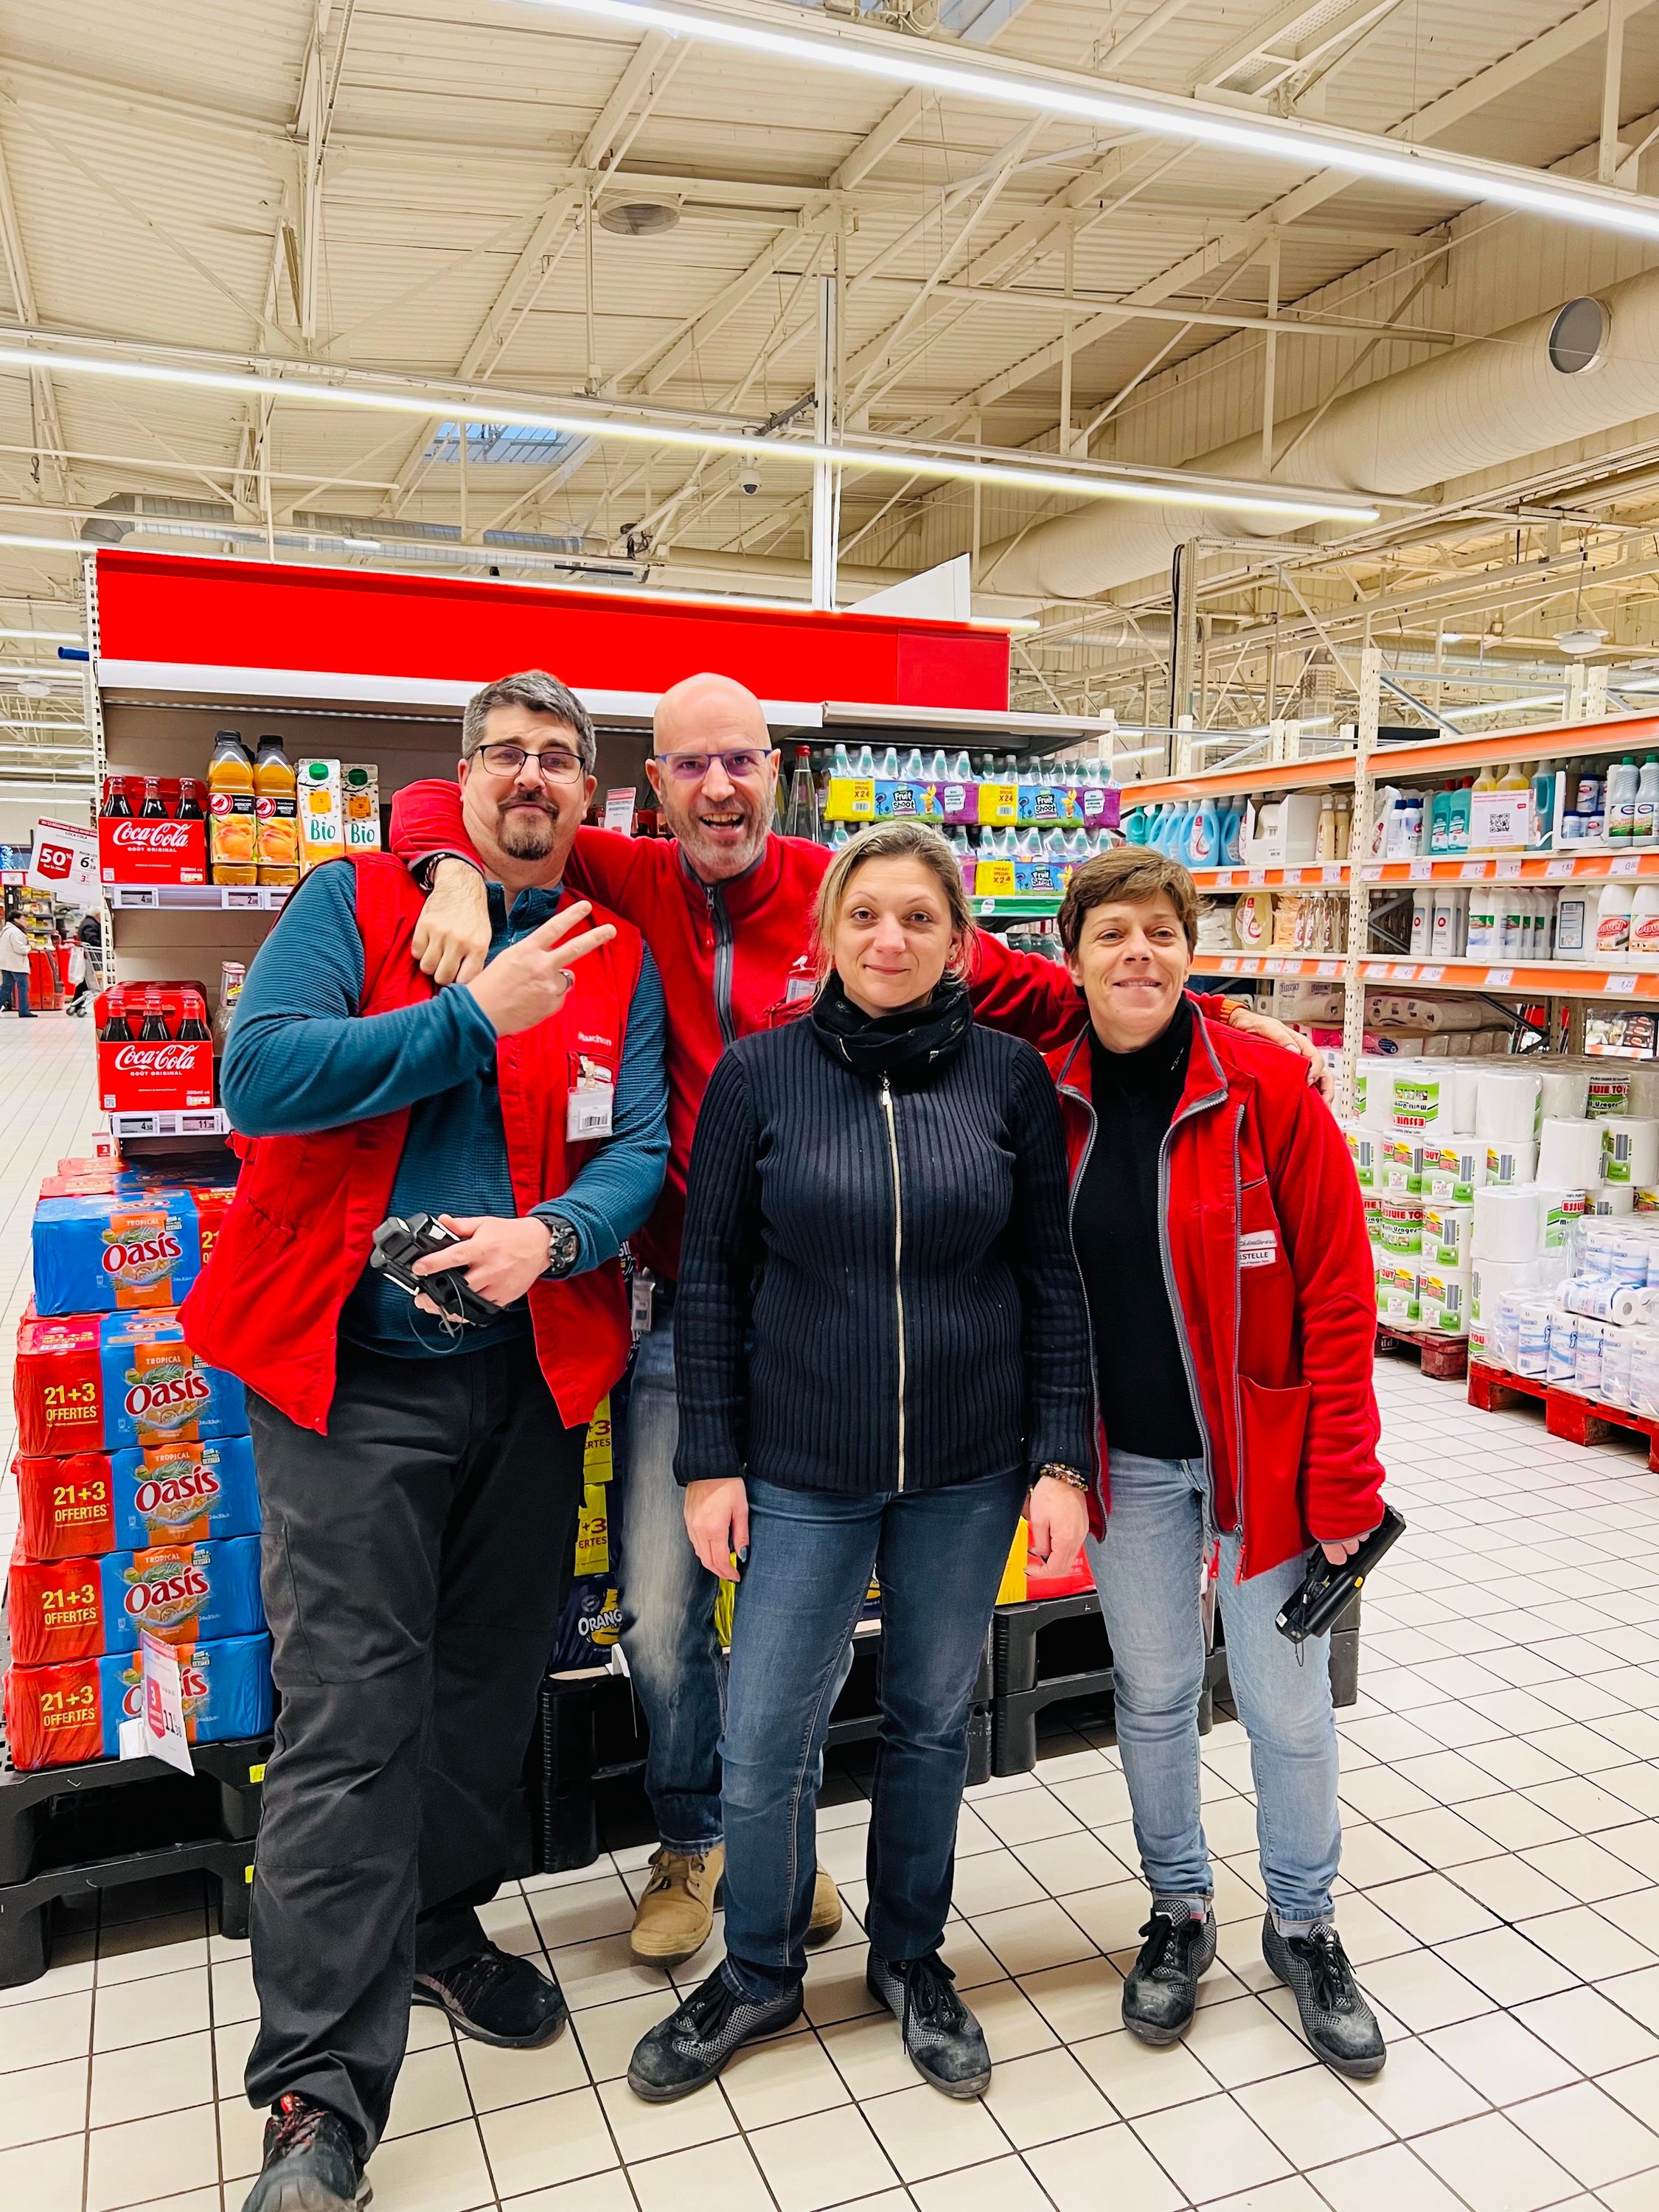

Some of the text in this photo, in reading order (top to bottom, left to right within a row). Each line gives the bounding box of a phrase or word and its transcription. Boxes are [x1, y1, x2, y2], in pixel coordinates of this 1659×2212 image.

[894, 790, 913, 801] Fruit
[1037, 795, 1054, 805] Fruit
[893, 801, 915, 810] Shoot
[1036, 804, 1057, 813] Shoot
[113, 821, 192, 847] Coca-Cola
[311, 819, 335, 841] Bio
[351, 823, 375, 844] Bio
[1032, 871, 1050, 879] Fruit
[115, 1044, 200, 1071] Coca-Cola
[1589, 1085, 1610, 1093] SUIE
[1383, 1144, 1394, 1154] OUT
[1563, 1201, 1585, 1211] ESSU
[126, 1219, 160, 1227] TROPICAL
[103, 1231, 181, 1273] Oasis
[1471, 1333, 1485, 1344] TOU
[146, 1355, 181, 1365] TROPICAL
[44, 1382, 96, 1405] 21+3
[125, 1370, 210, 1415] Oasis
[46, 1405, 97, 1422] OFFERTES
[584, 1439, 611, 1450] ERTES
[155, 1451, 190, 1461] TROPICAL
[53, 1481, 106, 1506] 21+3
[135, 1466, 219, 1512] Oasis
[55, 1505, 107, 1523] OFFERTES
[579, 1536, 608, 1549] ERTES
[145, 1553, 181, 1564] TROPICAL
[41, 1585, 95, 1610] 21+3
[125, 1565, 209, 1615] Oasis
[44, 1607, 97, 1625] OFFERTES
[578, 1608, 623, 1636] ORANG
[41, 1685, 94, 1712] 21+3
[123, 1668, 209, 1716] Ois
[44, 1708, 96, 1727] OFFERTES
